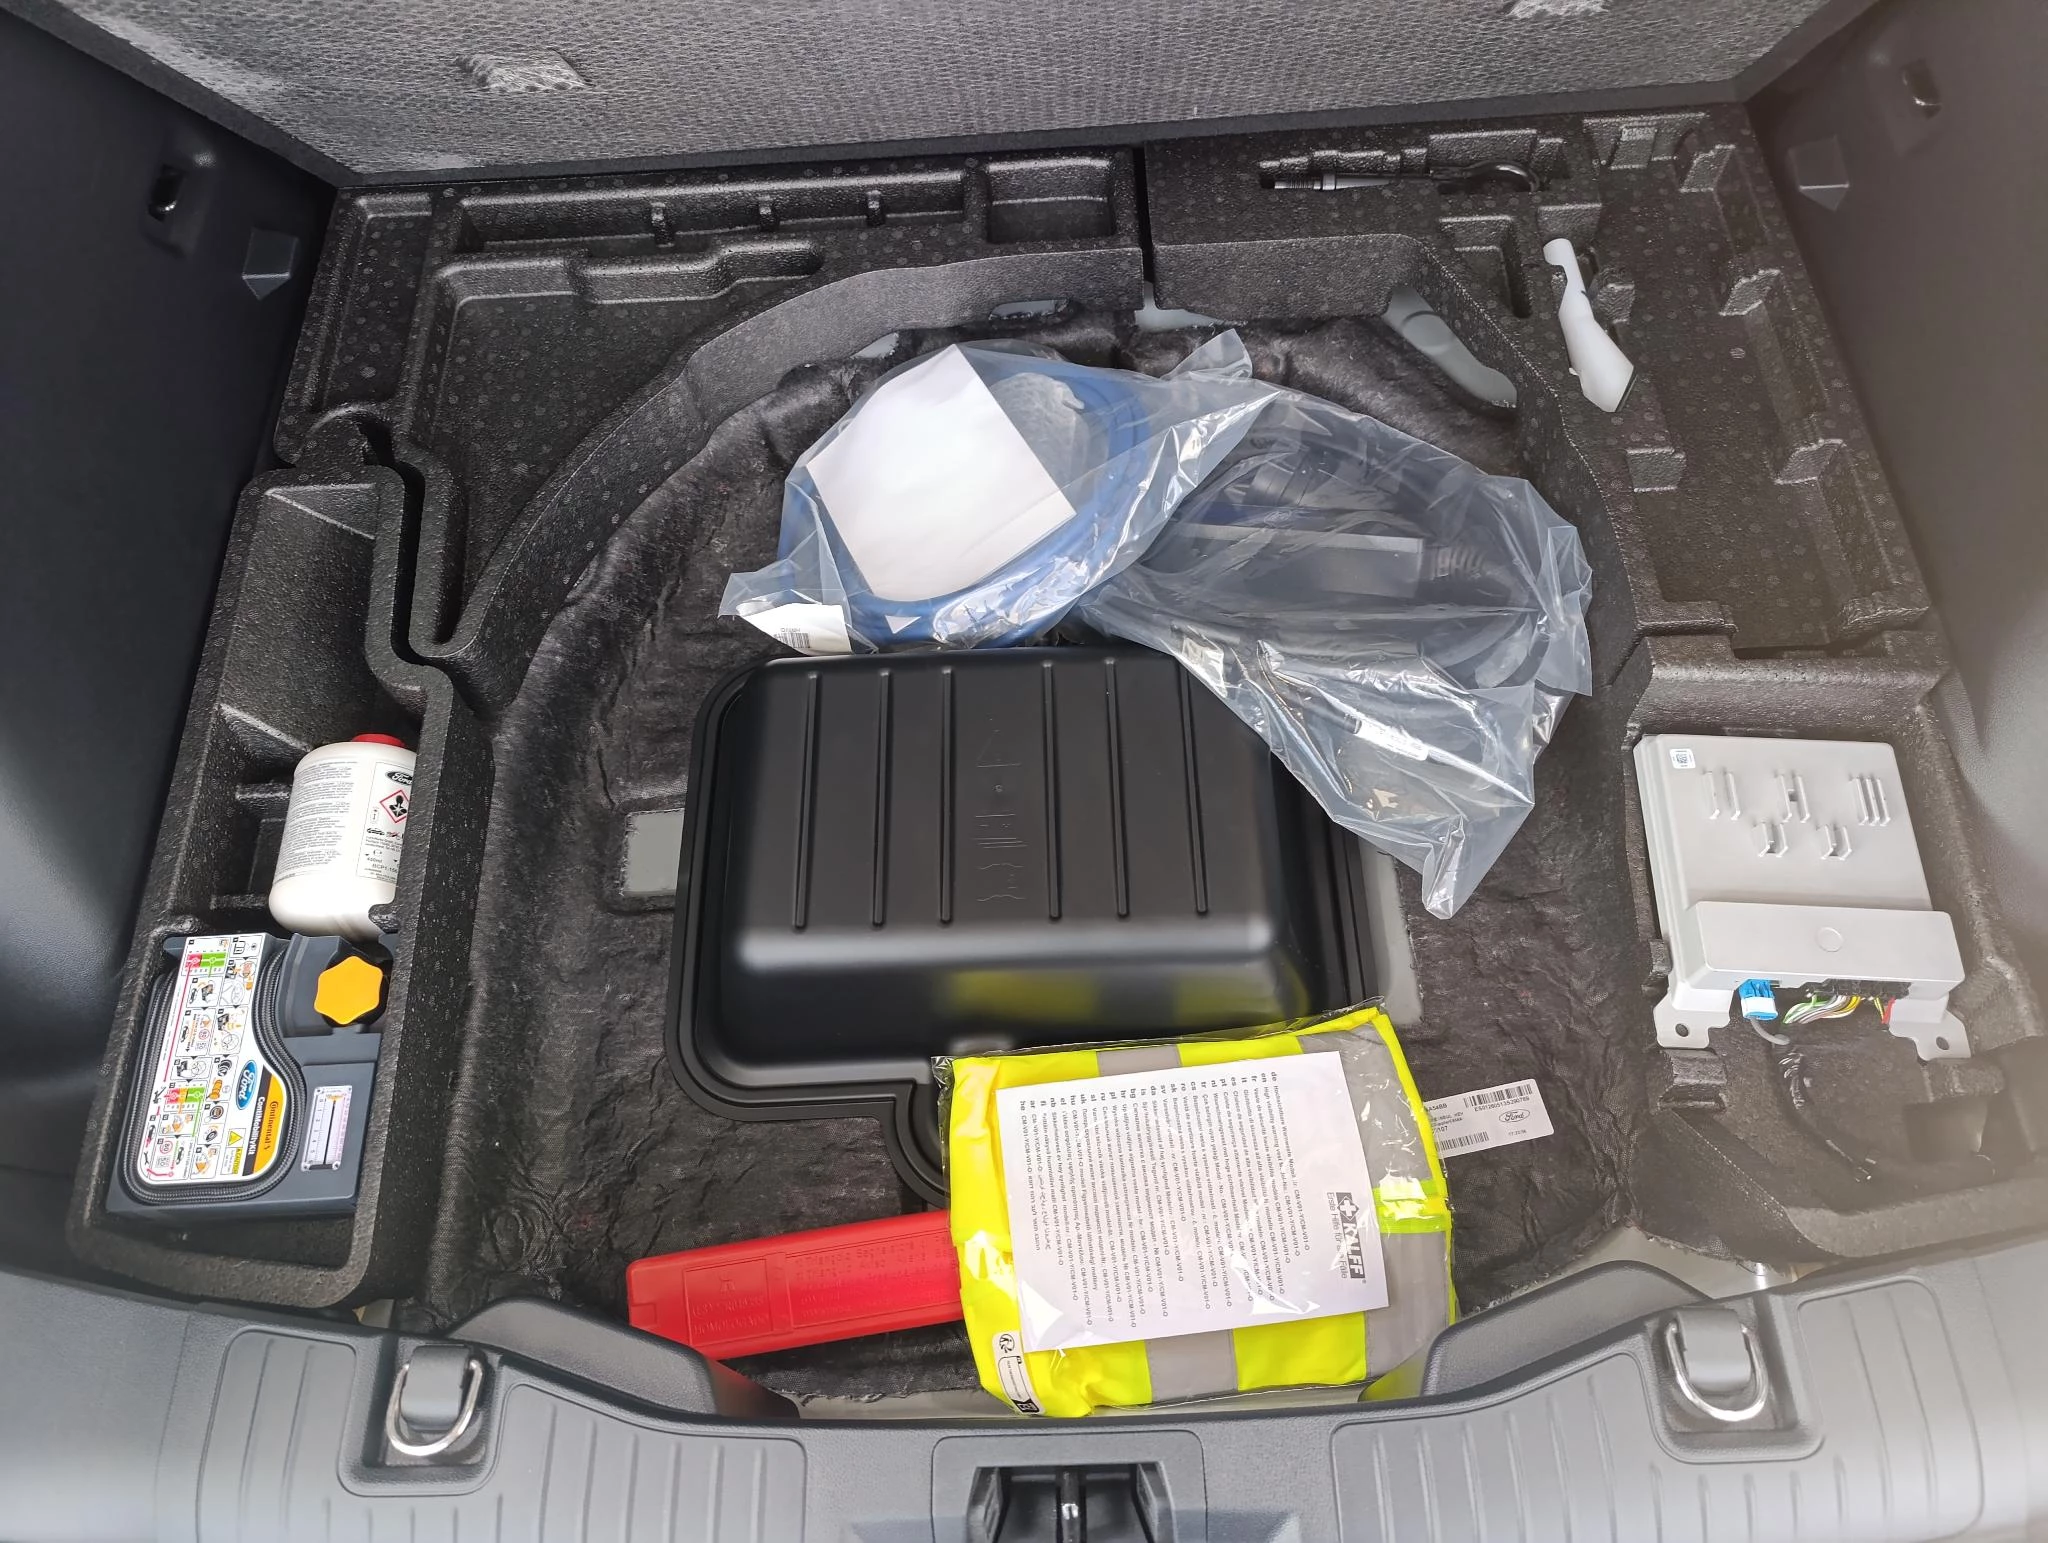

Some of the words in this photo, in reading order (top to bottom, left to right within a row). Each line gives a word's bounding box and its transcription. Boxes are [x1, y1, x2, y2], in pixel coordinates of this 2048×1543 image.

[248, 1096, 266, 1156] ContiMobilityKit
[265, 1100, 279, 1145] Continental
[1326, 1191, 1337, 1211] Erste
[1330, 1213, 1340, 1230] Hilfe
[1333, 1232, 1342, 1242] für
[1341, 1220, 1366, 1276] KALFF
